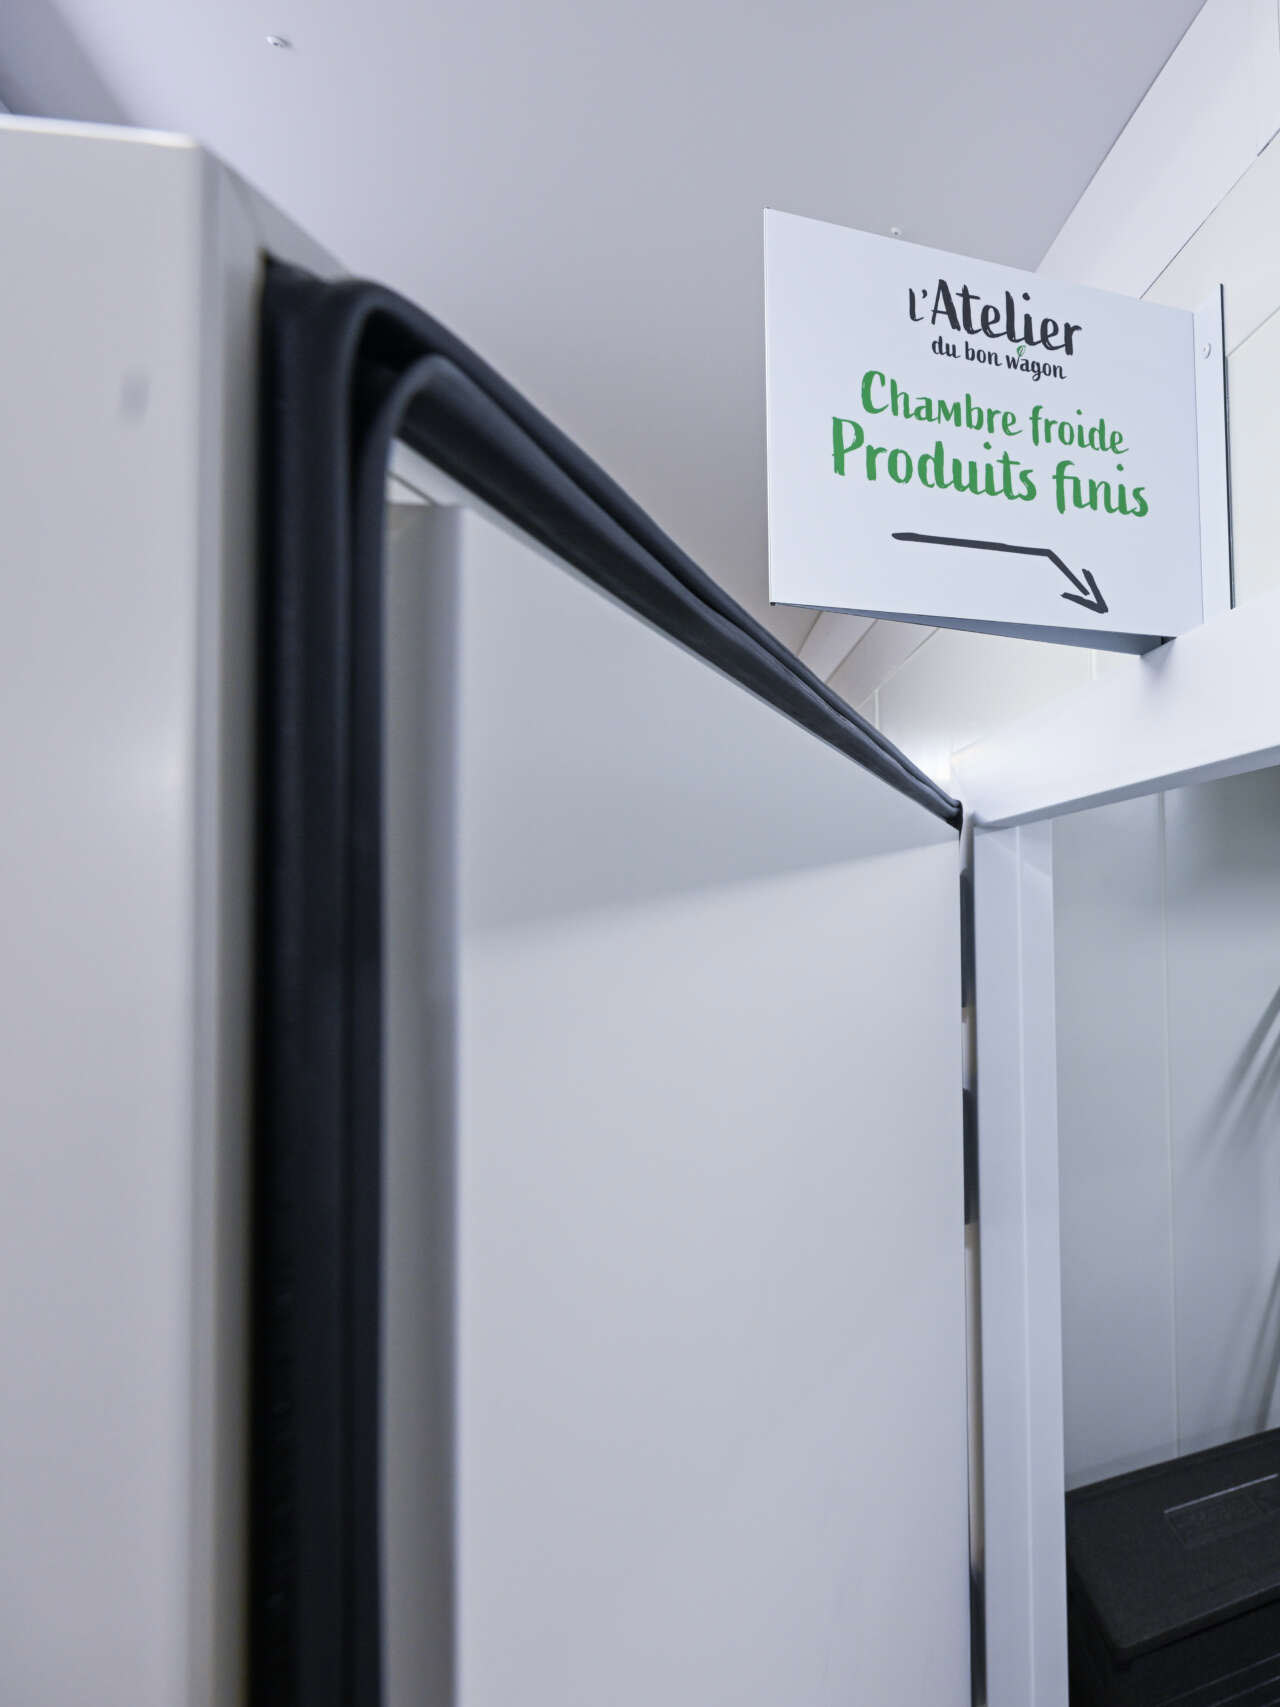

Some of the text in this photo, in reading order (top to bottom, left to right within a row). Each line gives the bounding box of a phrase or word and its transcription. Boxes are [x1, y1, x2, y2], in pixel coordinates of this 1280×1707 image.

[931, 335, 1067, 382] du bon wagon
[861, 370, 1130, 455] Chambre froide
[831, 416, 1150, 518] Produits finis
